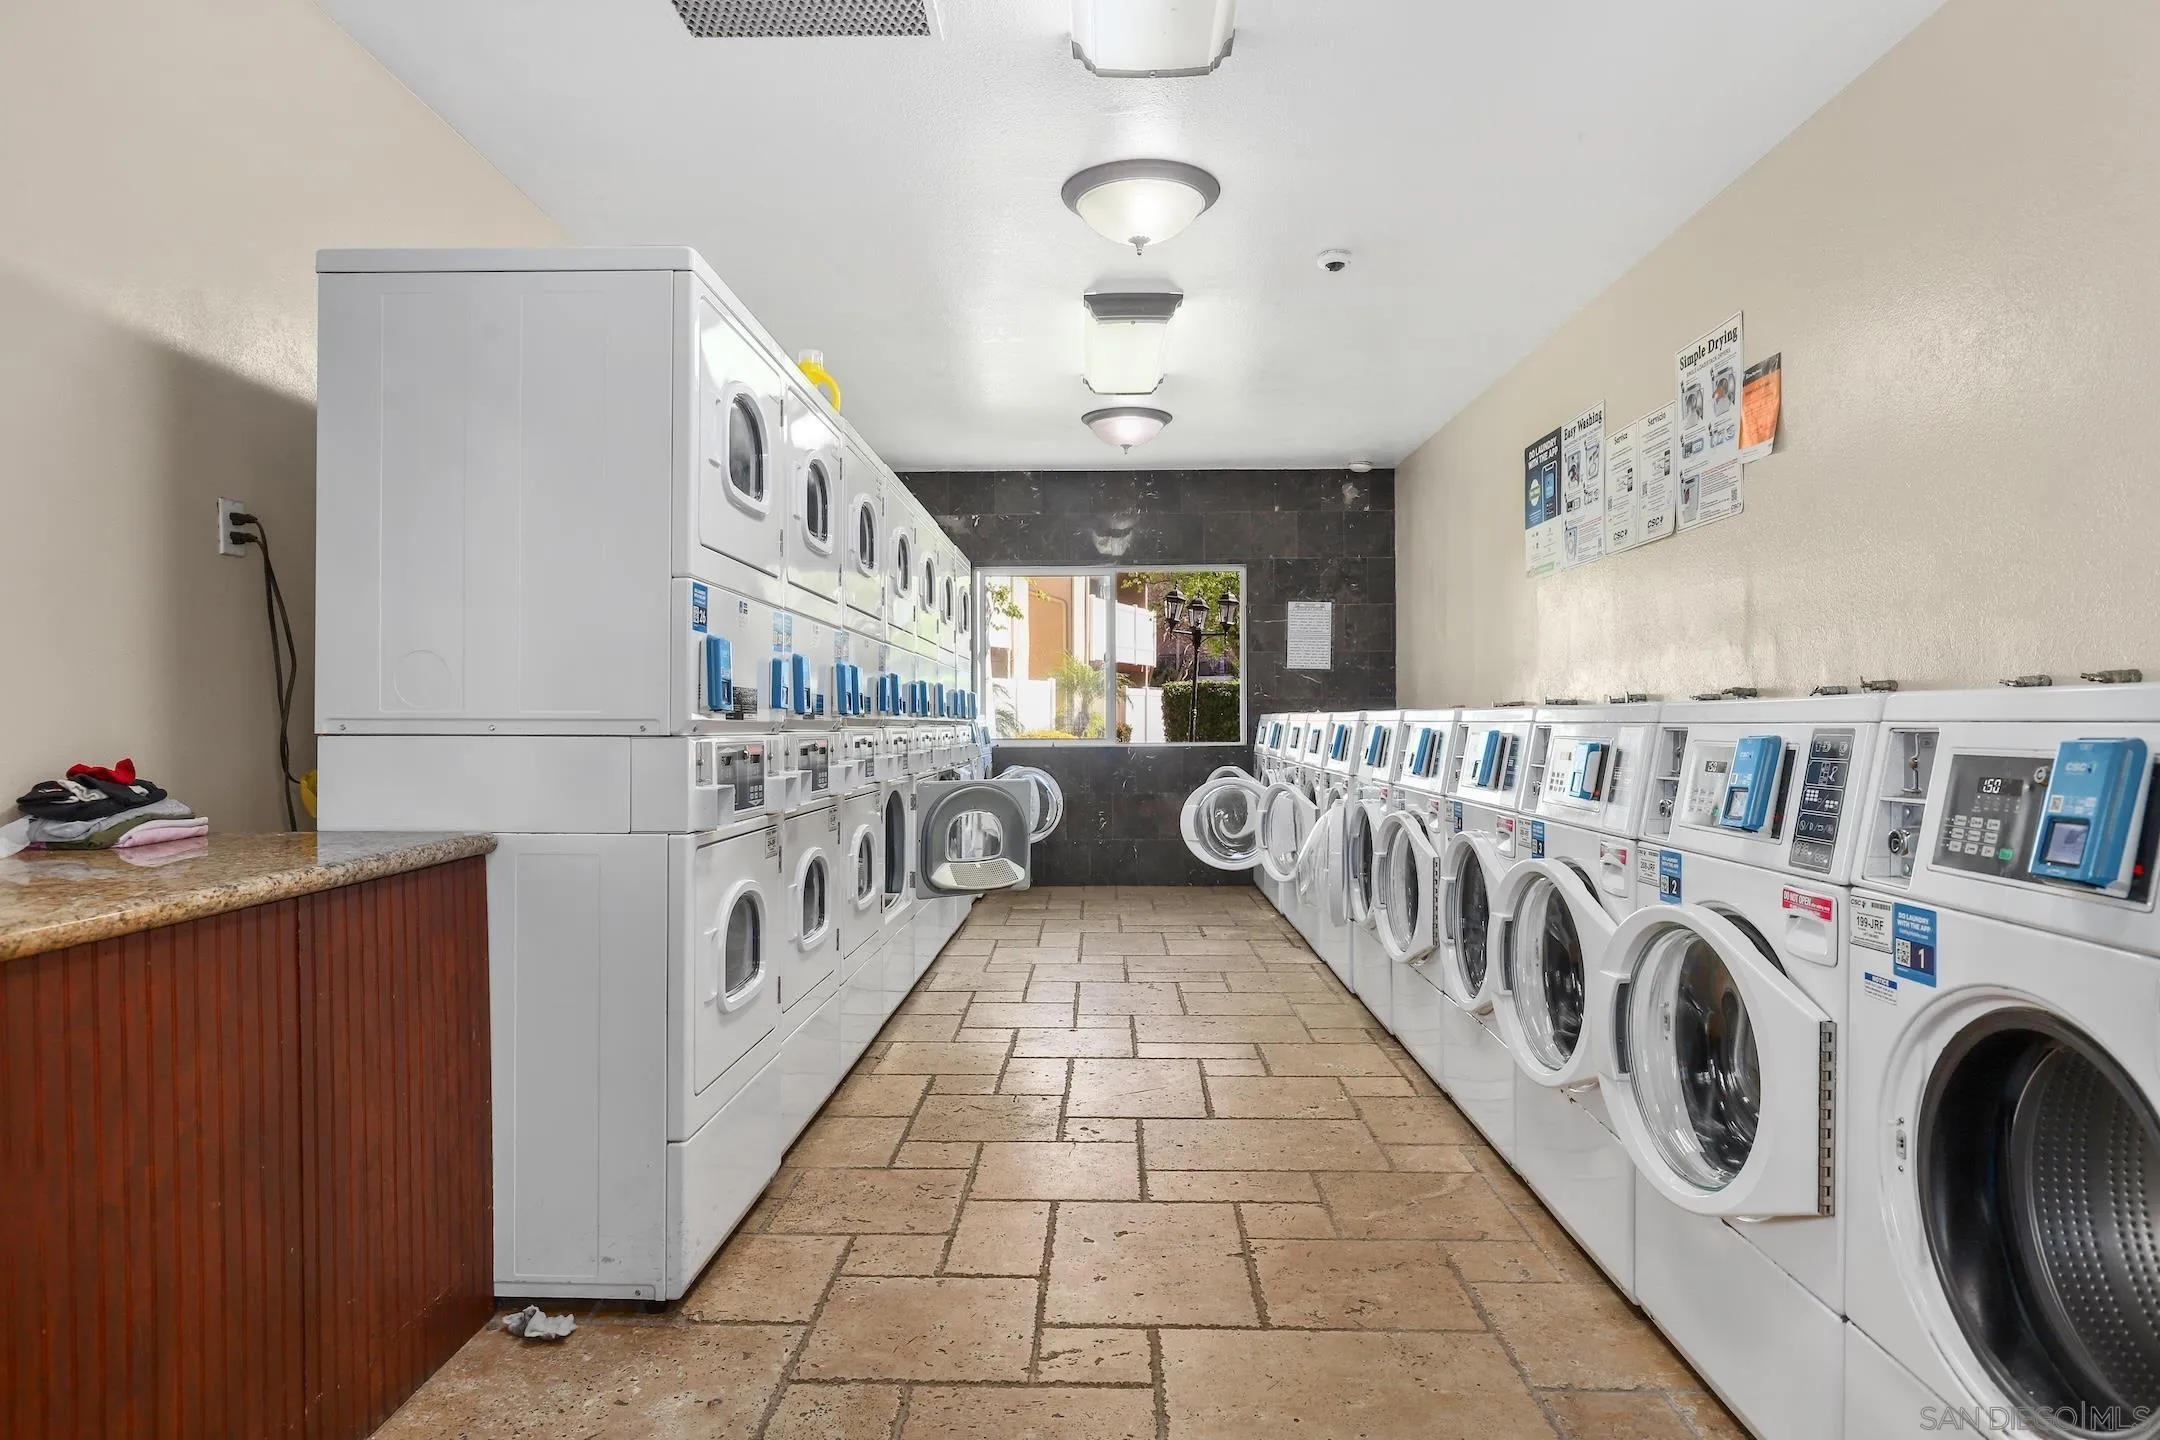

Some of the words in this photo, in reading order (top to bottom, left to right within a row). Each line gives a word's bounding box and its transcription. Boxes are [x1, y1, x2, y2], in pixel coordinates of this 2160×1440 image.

[1679, 344, 1706, 371] Simple
[1707, 326, 1738, 354] Drying
[1564, 427, 1577, 441] Easy
[1577, 410, 1602, 432] Washing
[1647, 517, 1660, 529] CSC
[1613, 530, 1625, 541] CSC
[1538, 842, 1543, 855] 3
[1671, 879, 1678, 895] 2
[1783, 890, 1791, 901] DO
[1790, 891, 1799, 904] NOT
[1799, 895, 1811, 906] OPEN
[1850, 898, 1861, 906] CSC
[1857, 915, 1884, 931] 199-JRF
[1897, 918, 1910, 929] WITH
[1910, 922, 1920, 931] THE
[1920, 924, 1931, 933] APP
[1898, 911, 1906, 919] DO
[1906, 913, 1929, 925] LAUNDRY
[1918, 948, 1925, 969] 1
